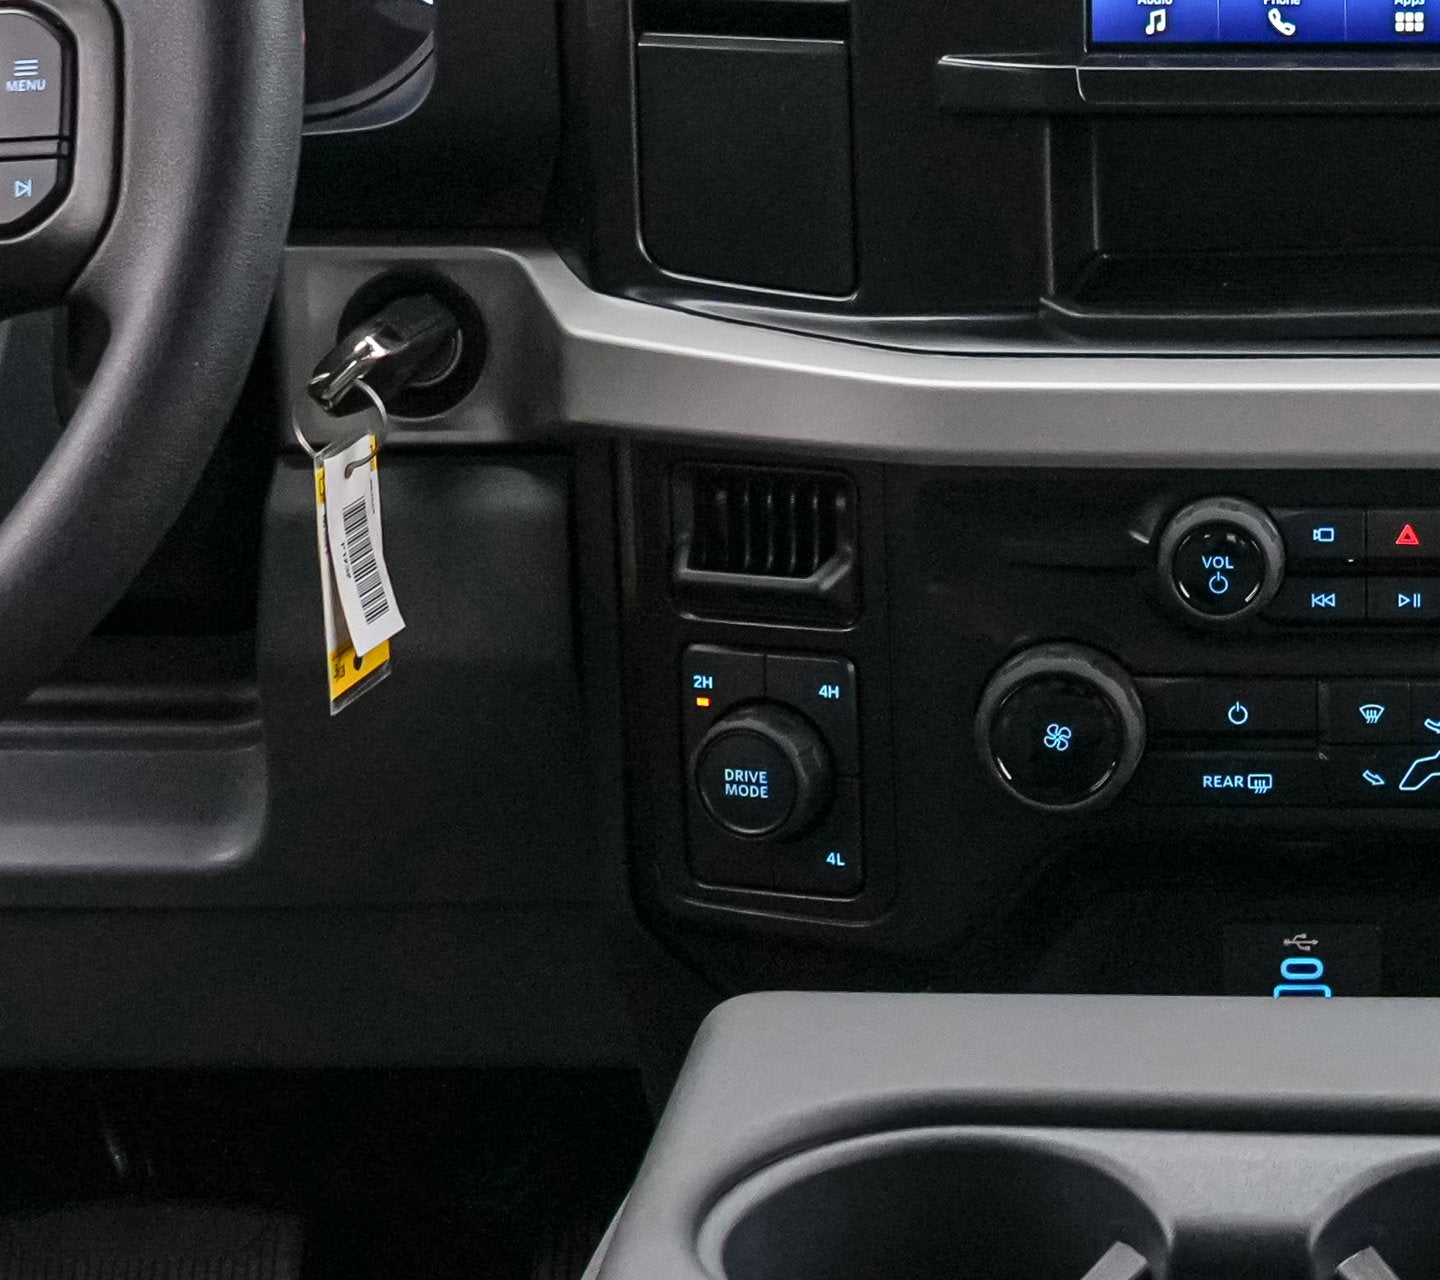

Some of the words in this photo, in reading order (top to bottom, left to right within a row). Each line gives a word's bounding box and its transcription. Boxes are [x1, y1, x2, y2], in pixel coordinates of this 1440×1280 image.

[5, 78, 46, 92] MENU
[1202, 555, 1234, 570] VOL
[692, 675, 713, 690] 2H
[818, 685, 840, 699] 4H
[724, 770, 768, 784] DRIVE
[1202, 775, 1245, 789] REAR
[724, 784, 769, 798] MODE
[826, 852, 845, 867] 4L
